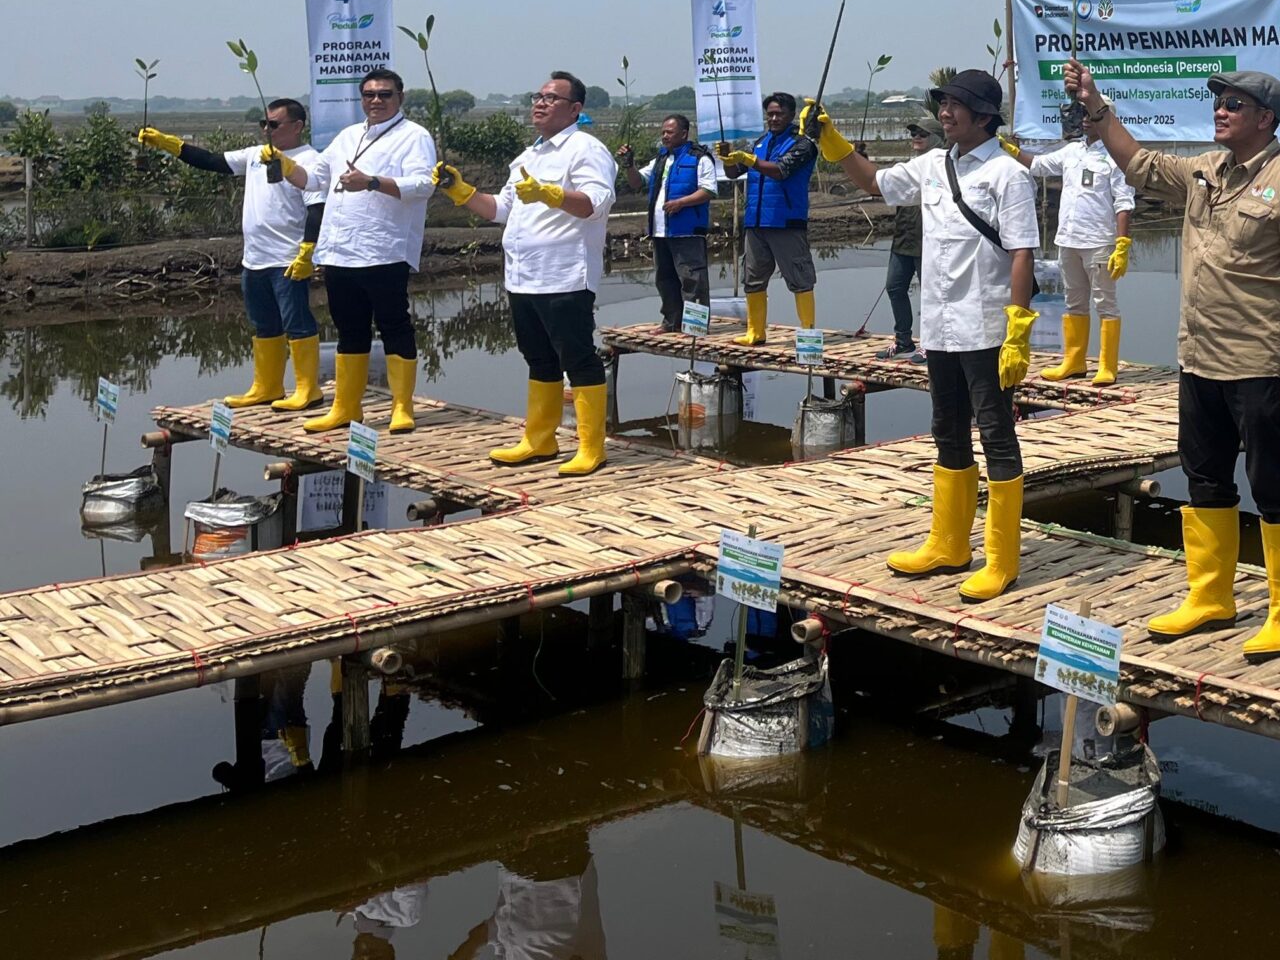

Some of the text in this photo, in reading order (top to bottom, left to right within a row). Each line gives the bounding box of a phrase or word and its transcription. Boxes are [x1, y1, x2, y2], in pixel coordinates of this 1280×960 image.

[1035, 33, 1125, 52] PROGRAM
[1127, 26, 1248, 50] PENANAMAN
[322, 40, 381, 51] PROGRAM
[704, 47, 748, 55] PROGRAM
[315, 52, 390, 64] PENANAMAN
[319, 64, 386, 75] MANGROVE
[701, 66, 752, 75] MANGROVE
[1088, 62, 1120, 75] buhan
[1123, 61, 1173, 74] Indonesia
[1176, 59, 1222, 75] (Persero)
[1117, 114, 1175, 125] tember 2025
[1051, 629, 1081, 645] KEMENTERIAN
[1081, 640, 1111, 656] KEHUTANAN
